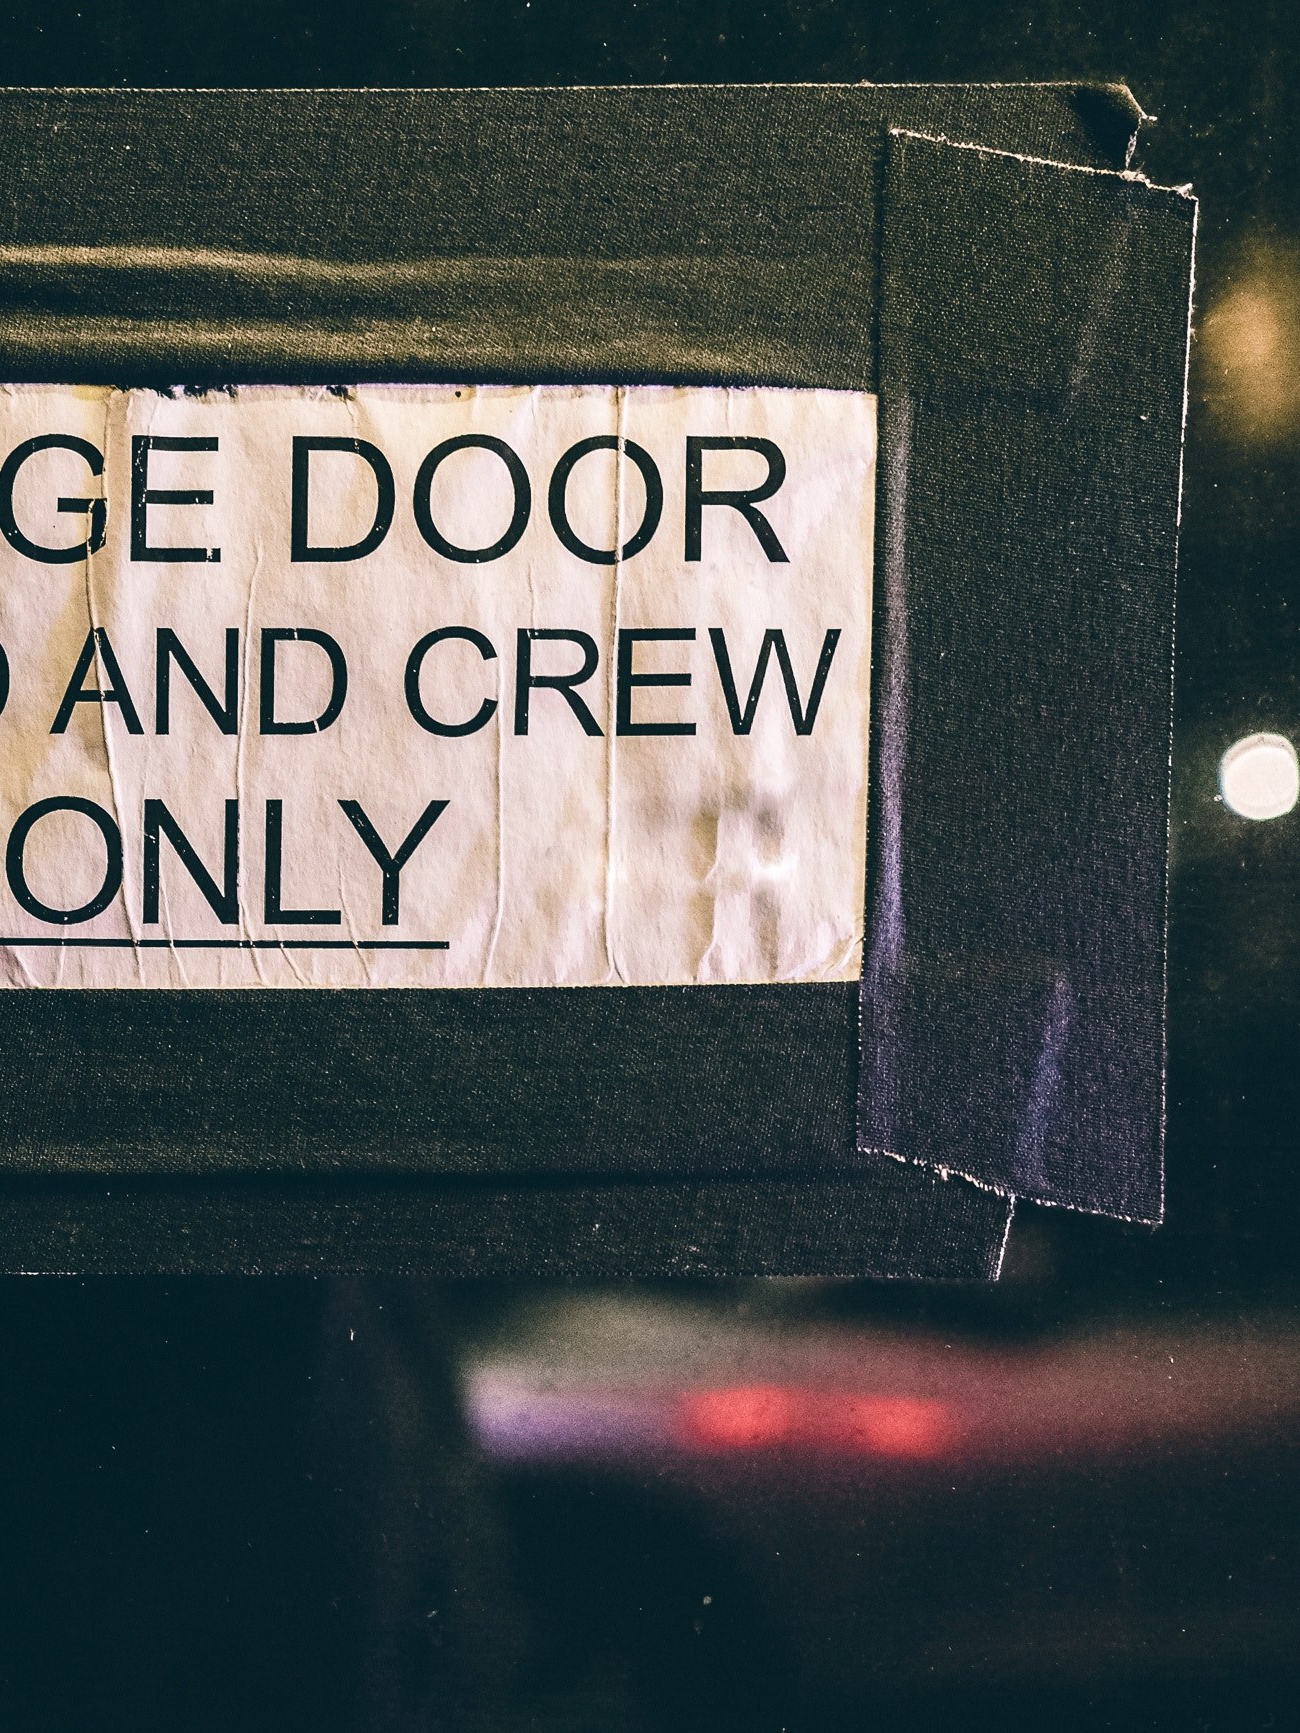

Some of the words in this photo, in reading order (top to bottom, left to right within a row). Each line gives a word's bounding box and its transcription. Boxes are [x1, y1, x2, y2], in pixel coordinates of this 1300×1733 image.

[290, 434, 792, 564] DOOR
[50, 627, 348, 736] AND
[404, 626, 841, 738] CREW
[6, 796, 450, 926] ONLY
